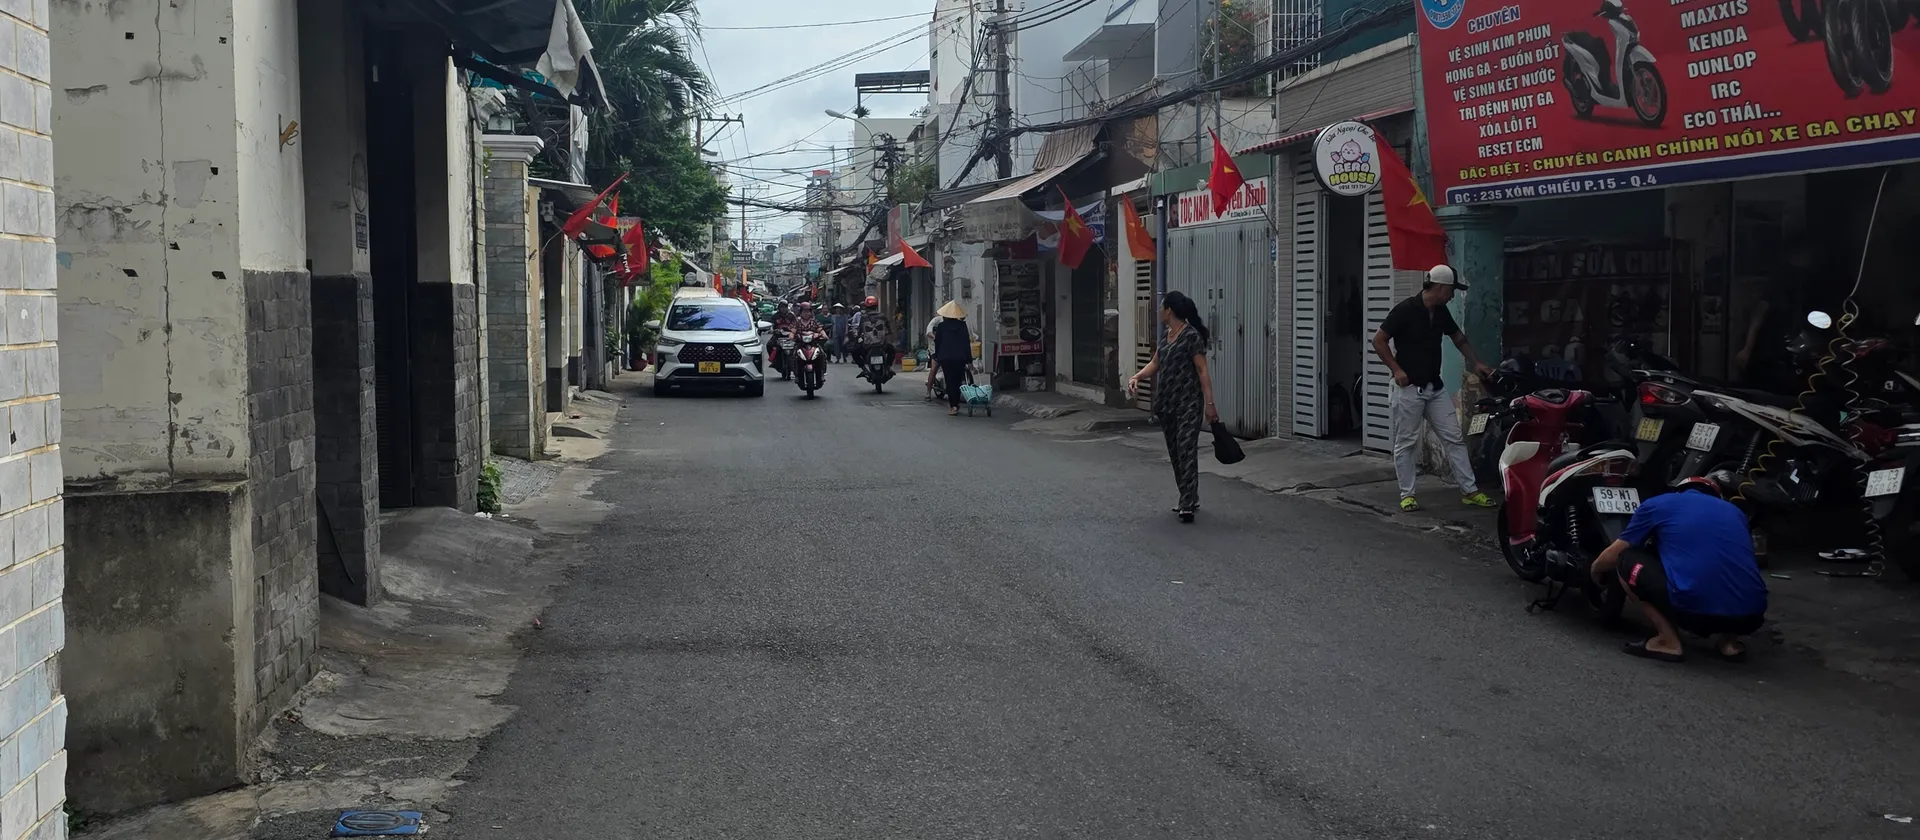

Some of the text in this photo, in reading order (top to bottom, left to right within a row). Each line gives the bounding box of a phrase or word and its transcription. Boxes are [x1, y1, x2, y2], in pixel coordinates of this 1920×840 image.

[1468, 5, 1521, 34] CHUYÊN
[1681, 0, 1748, 28] MAXXIS
[1449, 24, 1551, 64] VỆ SINH KIM PHUN
[1688, 26, 1748, 52] KENDA
[1446, 67, 1475, 86] HỌNG
[1477, 61, 1492, 76] GA
[1687, 51, 1757, 78] DUNLOP
[1453, 87, 1467, 104] VỆ
[1469, 81, 1496, 99] SINH
[1521, 68, 1556, 87] NƯỚC
[1710, 80, 1741, 100] IRC
[1459, 91, 1555, 121] TRỊ BỆNH HỤT GA
[1479, 120, 1502, 139] XÓA
[1526, 116, 1537, 130] FI
[1683, 112, 1717, 130] ECO
[1459, 166, 1487, 181] ĐẶC
[1490, 160, 1521, 177] BIỆT
[1532, 152, 1599, 171] CHUYÊN
[1602, 145, 1652, 163] CANH
[1655, 137, 1720, 157] CHỈNH
[1769, 125, 1800, 143] XE
[1806, 121, 1840, 138] GA
[1846, 109, 1917, 132] CHẠY
[1478, 137, 1543, 159] RESET ECM
[1329, 171, 1376, 186] HOUSE
[1334, 161, 1370, 174] BERO
[1454, 191, 1471, 204] ĐC
[1480, 189, 1503, 202] 235
[1505, 184, 1535, 199] XÓM
[1538, 178, 1581, 196] CHIẾU
[1584, 177, 1617, 191] P.15
[1630, 173, 1657, 188] Q.4
[1193, 194, 1210, 222] NAM
[1600, 488, 1631, 501] 59-N1
